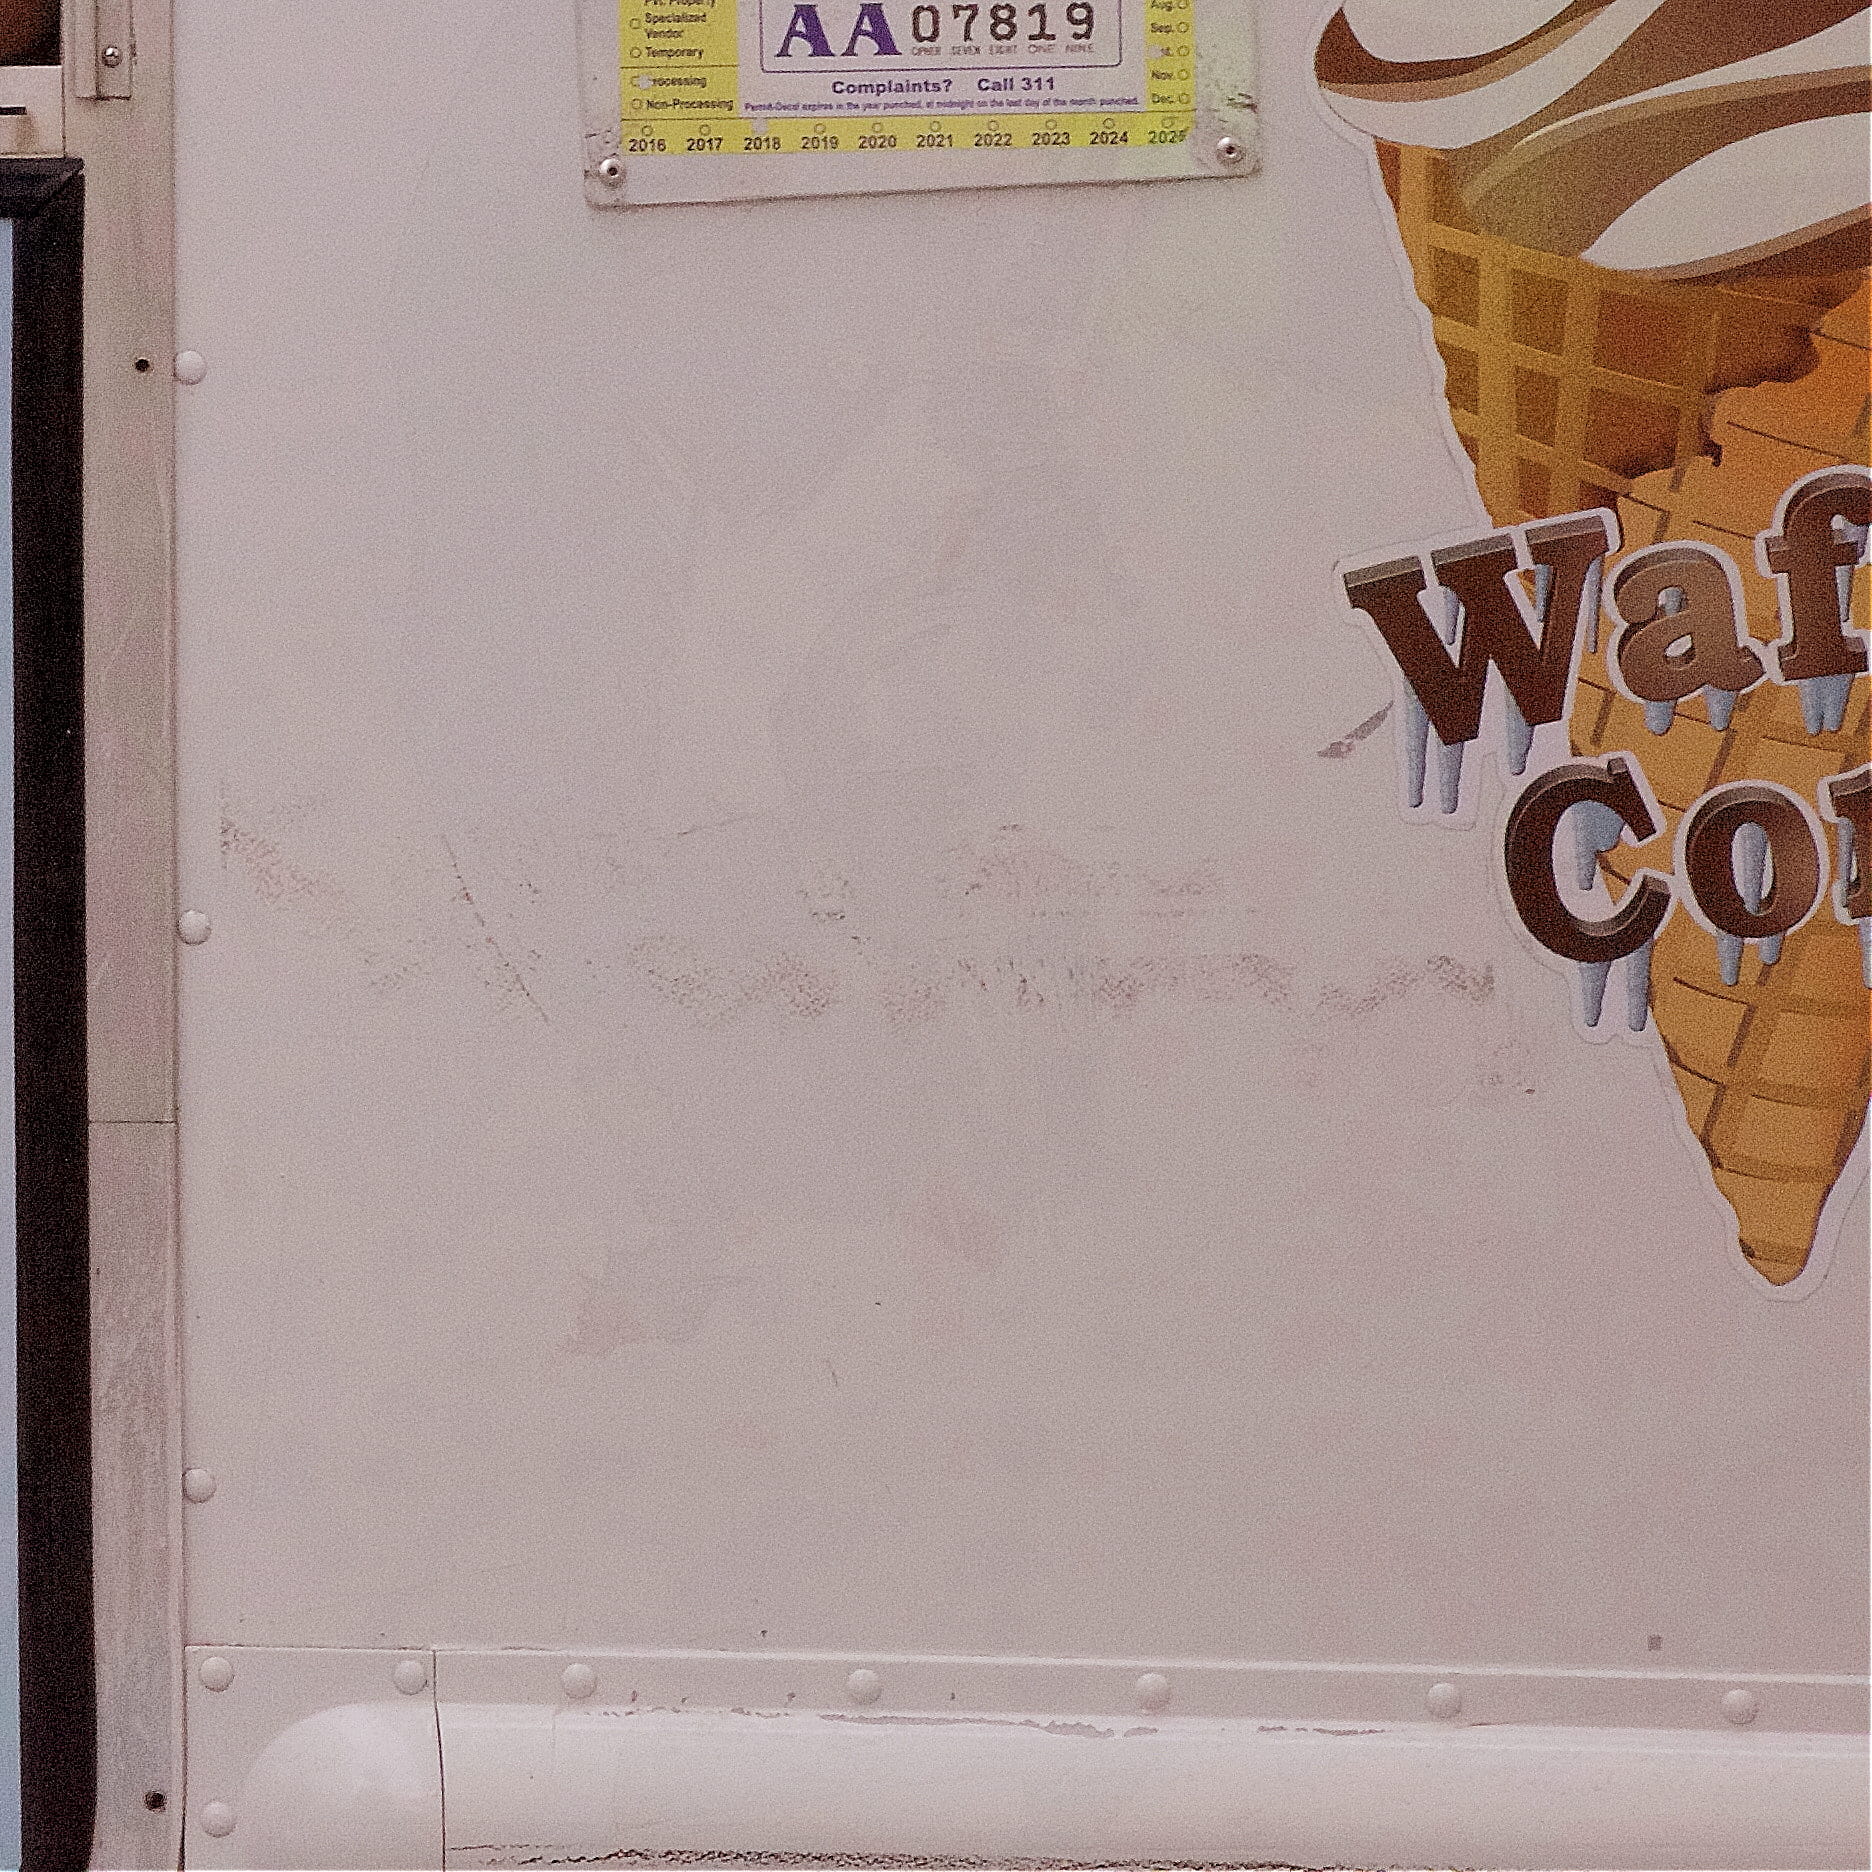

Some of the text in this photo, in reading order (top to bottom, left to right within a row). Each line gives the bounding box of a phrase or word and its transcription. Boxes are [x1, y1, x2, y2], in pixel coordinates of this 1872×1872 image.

[776, 2, 1095, 58] AA 07819
[646, 47, 704, 59] Temporary
[832, 77, 1055, 96] Complaints? Call 311
[647, 99, 733, 111] Non-Processing
[629, 138, 666, 153] 2016
[687, 138, 723, 152] 2017
[744, 137, 781, 150] 2018
[802, 136, 838, 149] 2019
[858, 135, 896, 148] 2020
[916, 134, 953, 148] 2021
[974, 133, 1012, 146] 2022
[1032, 132, 1070, 145] 2023
[1089, 131, 1129, 145] 2024
